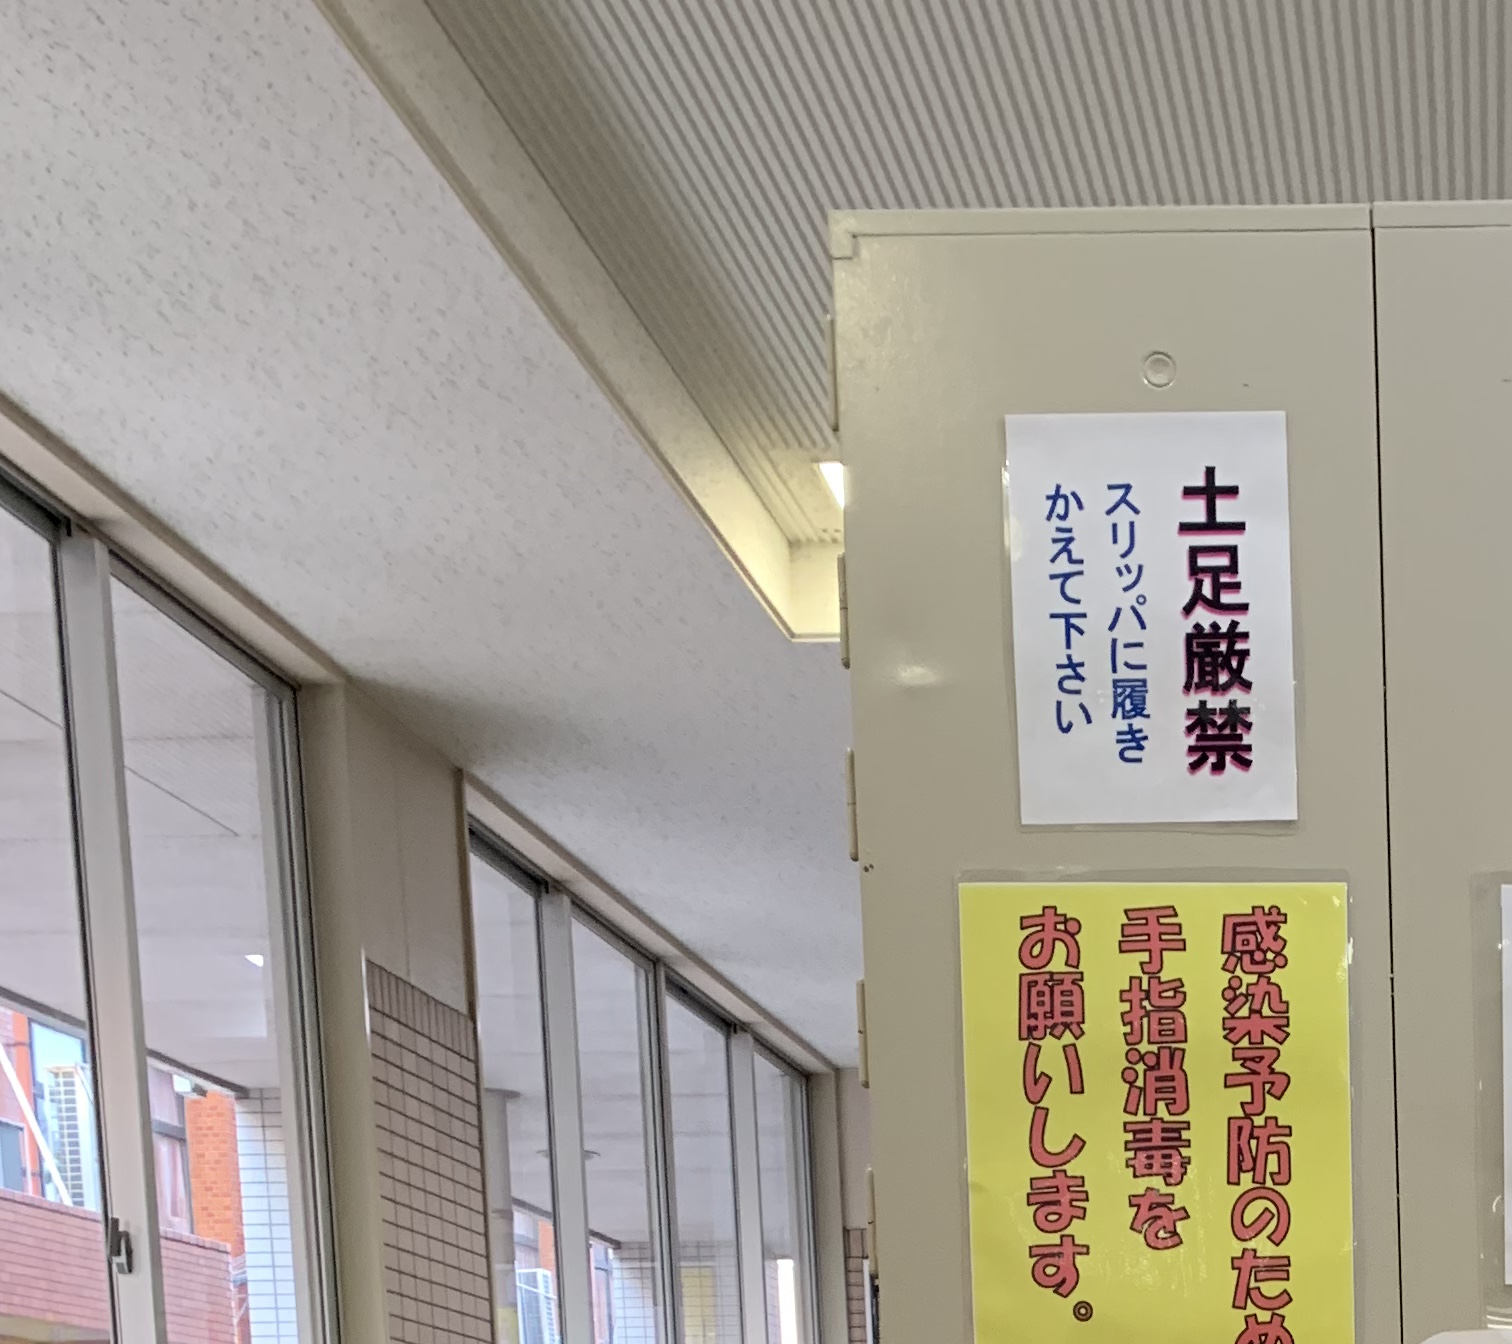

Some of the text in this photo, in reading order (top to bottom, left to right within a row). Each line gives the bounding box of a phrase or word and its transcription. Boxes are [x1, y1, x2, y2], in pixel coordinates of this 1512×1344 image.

[1045, 484, 1092, 734] かえて下さい
[1105, 483, 1150, 763] スリッパに履き
[1177, 466, 1254, 775] 土足厳禁
[1018, 905, 1093, 1321] お願いします。
[1118, 905, 1191, 1250] 手指消毒を
